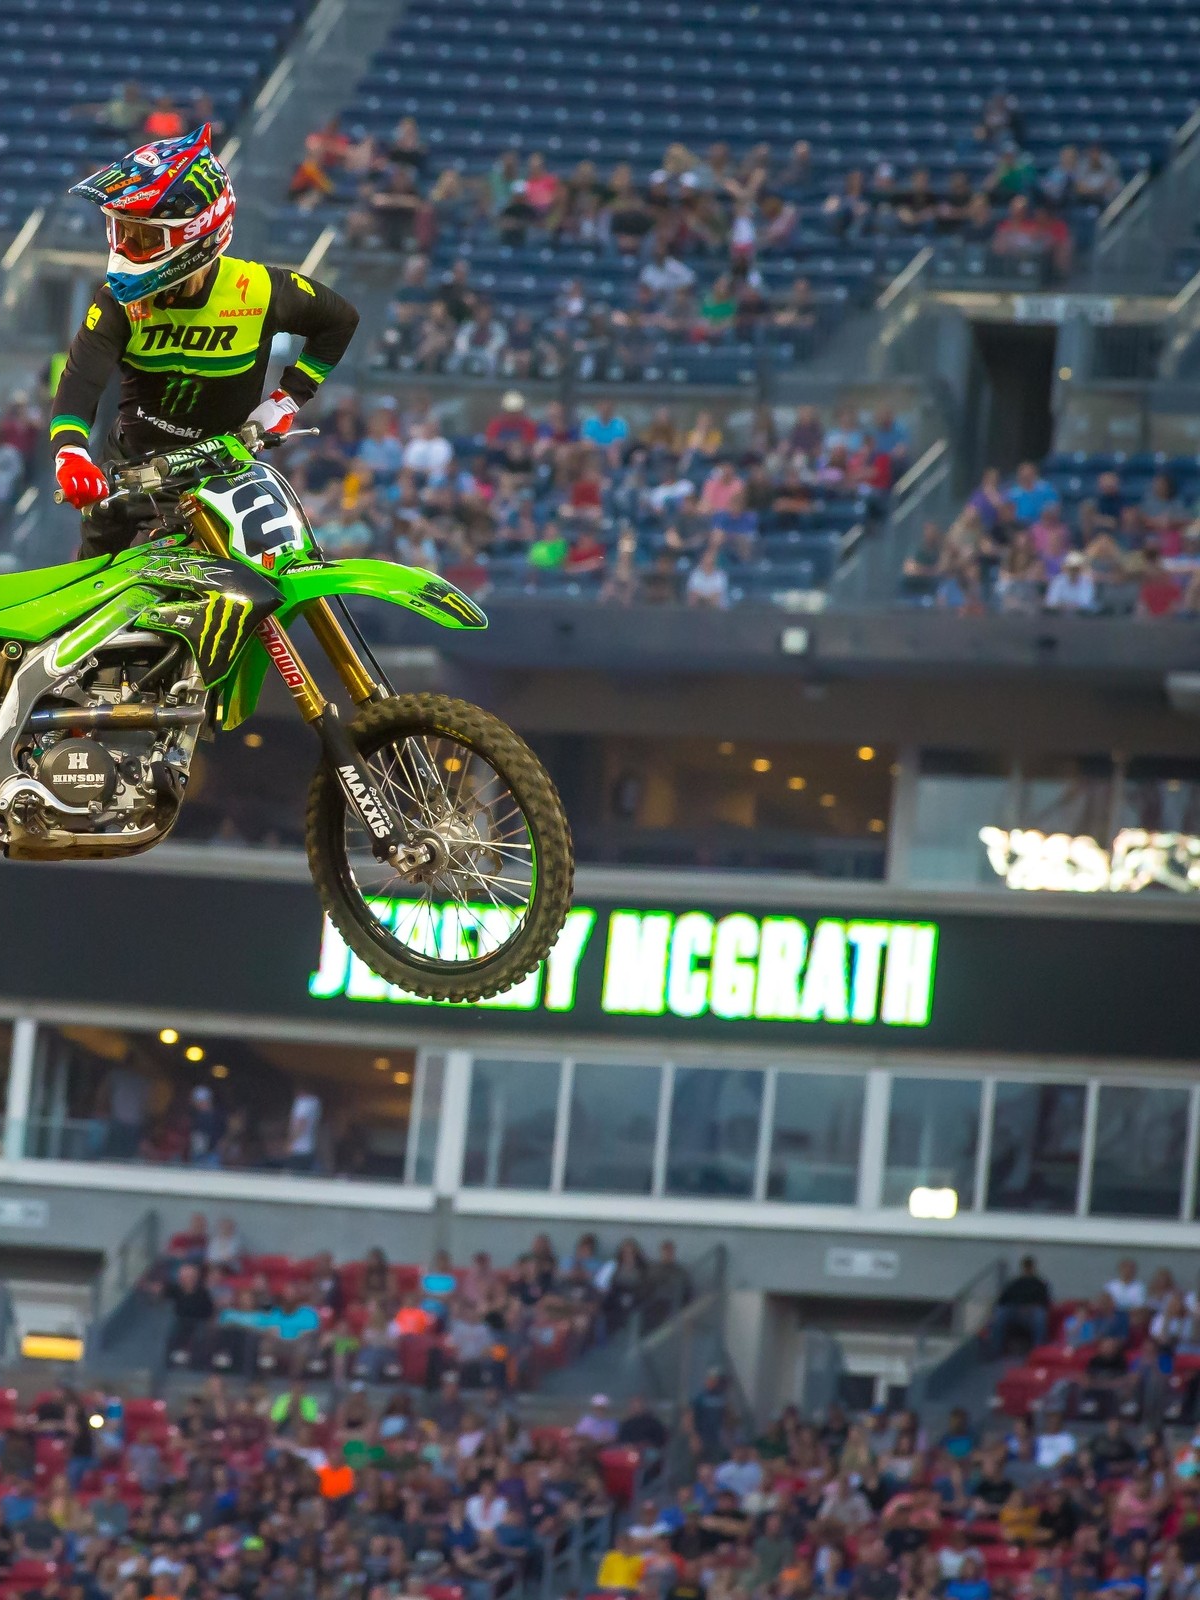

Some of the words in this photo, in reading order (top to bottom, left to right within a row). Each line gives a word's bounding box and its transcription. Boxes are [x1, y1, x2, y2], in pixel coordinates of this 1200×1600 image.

[105, 175, 142, 193] MAXXIS
[157, 251, 205, 280] MONSTER
[218, 307, 263, 318] MAXXIS
[140, 323, 238, 351] THOR
[232, 480, 297, 558] 2
[257, 618, 306, 688] SHOWA
[52, 773, 105, 782] HINSON
[339, 765, 390, 839] MAXXIS
[602, 908, 940, 1028] MCGRATH
